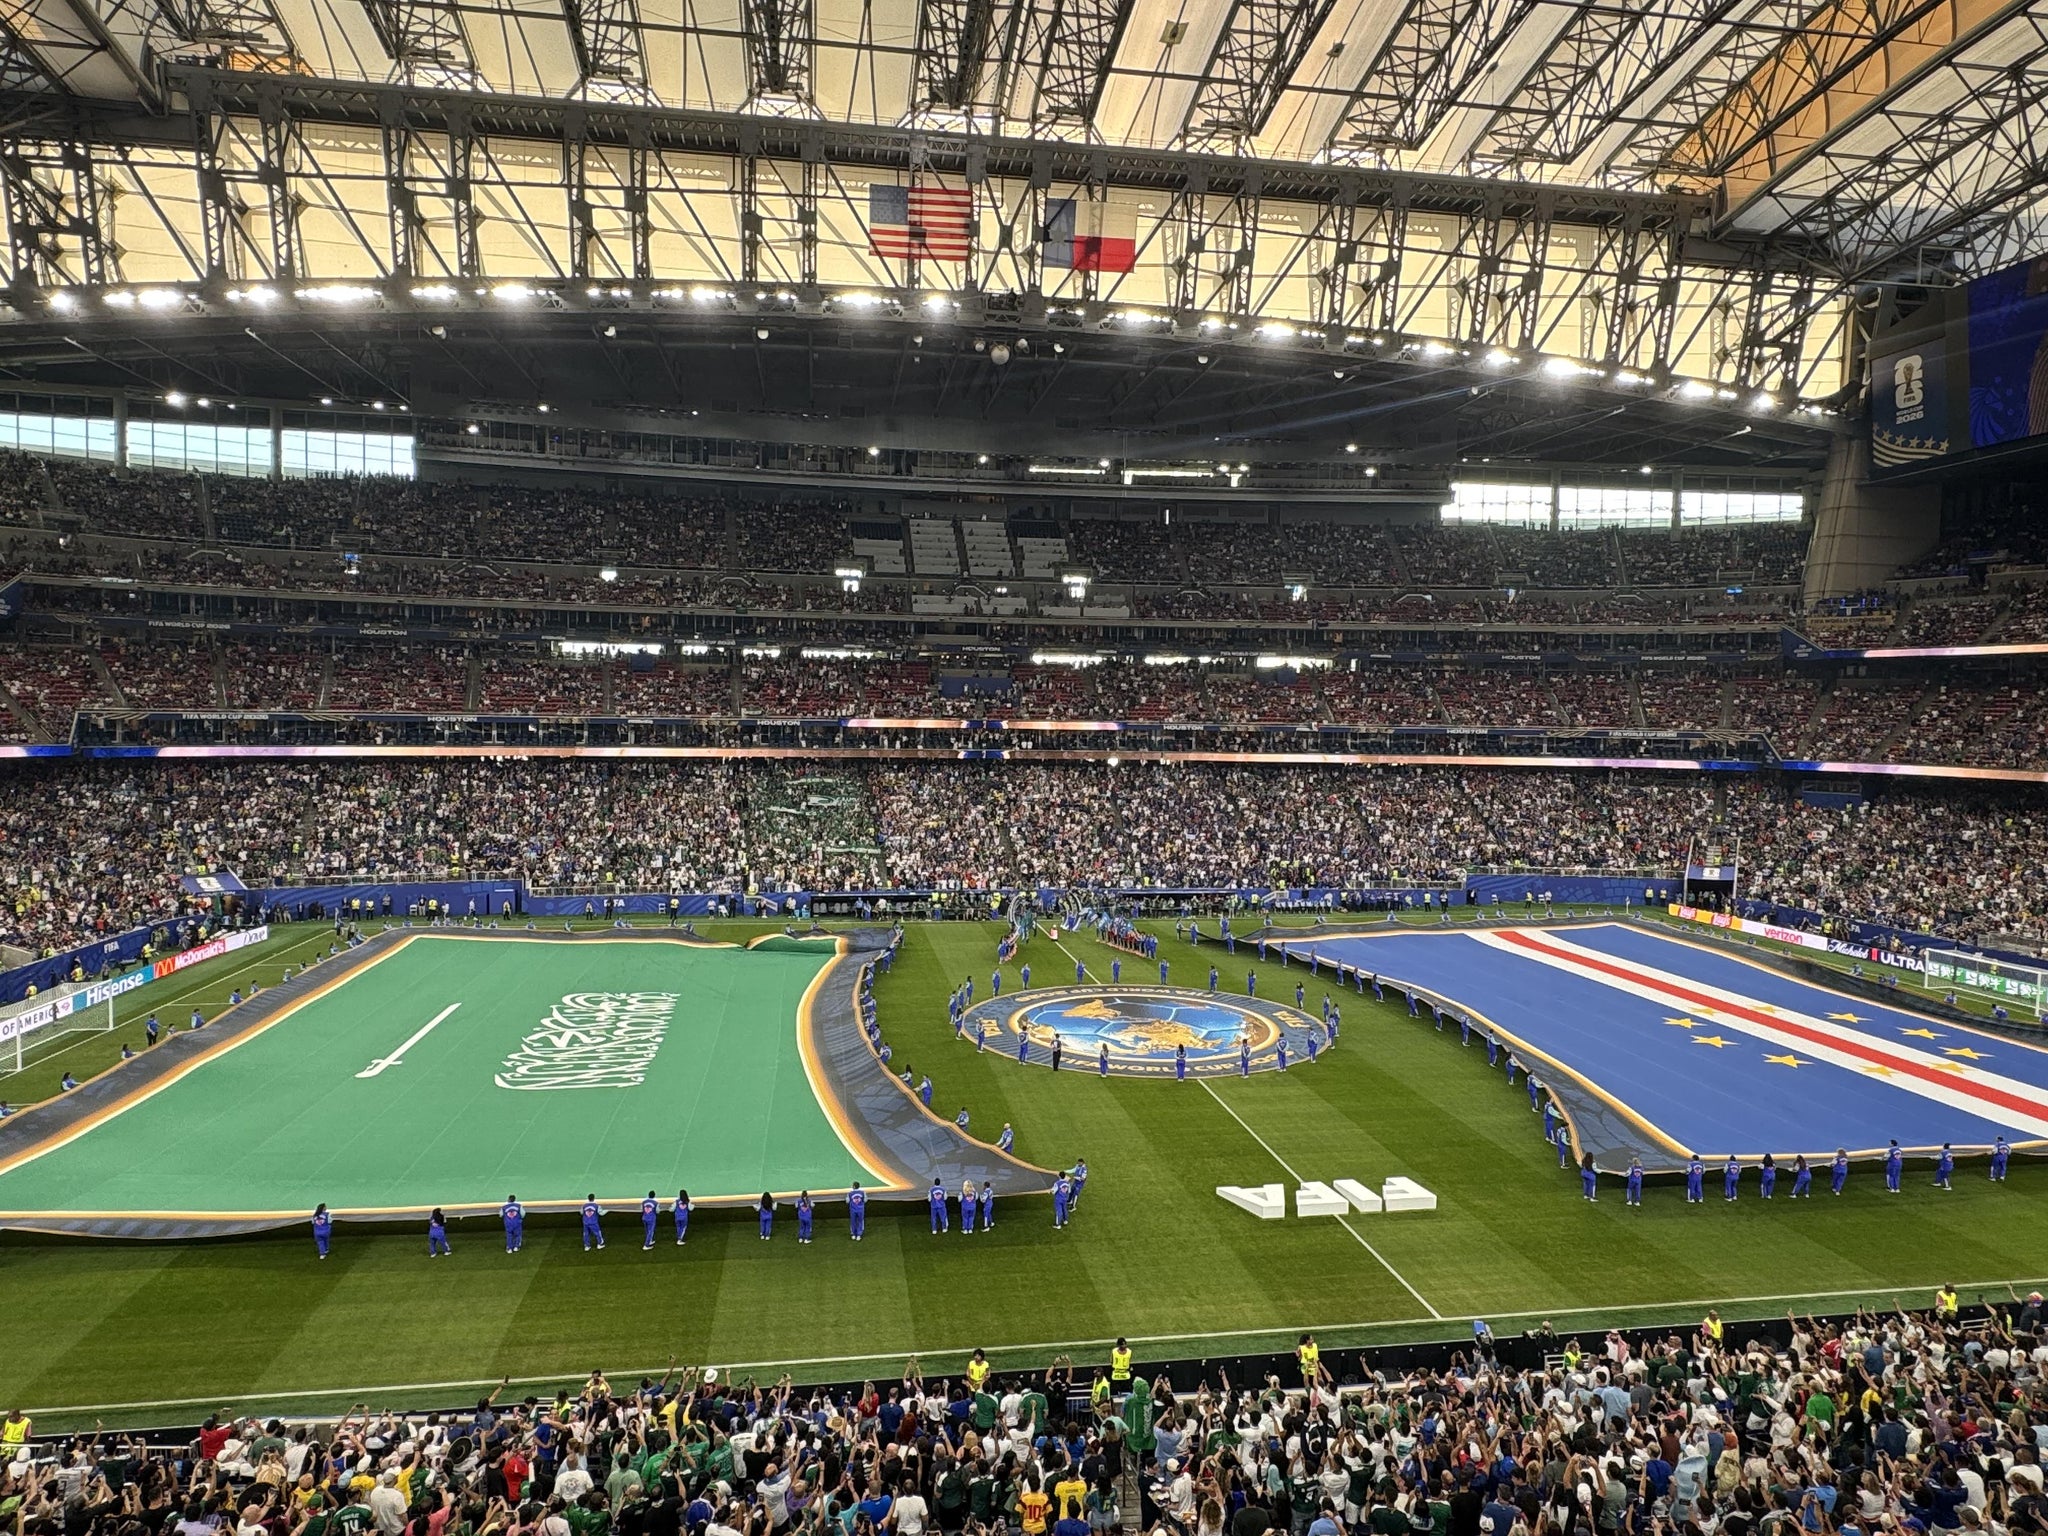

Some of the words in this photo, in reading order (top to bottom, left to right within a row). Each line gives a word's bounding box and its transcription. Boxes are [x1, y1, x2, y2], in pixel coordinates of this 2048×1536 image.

[1896, 411, 1924, 425] 2026
[603, 899, 625, 907] FFA
[243, 930, 265, 945] Dove
[1764, 927, 1803, 944] verizon
[104, 941, 120, 954] FIFA
[174, 942, 225, 969] McDonald's
[1828, 939, 1869, 959] Michelob
[1880, 952, 1925, 972] ULTRA
[86, 973, 144, 1007] Hisense
[2, 1022, 15, 1035] OF
[1060, 1057, 1101, 1068] FIFA
[1194, 1063, 1235, 1071] CUP
[1216, 1176, 1437, 1219] FIFA
[1027, 1505, 1042, 1520] 10
[343, 1519, 359, 1536] 14
